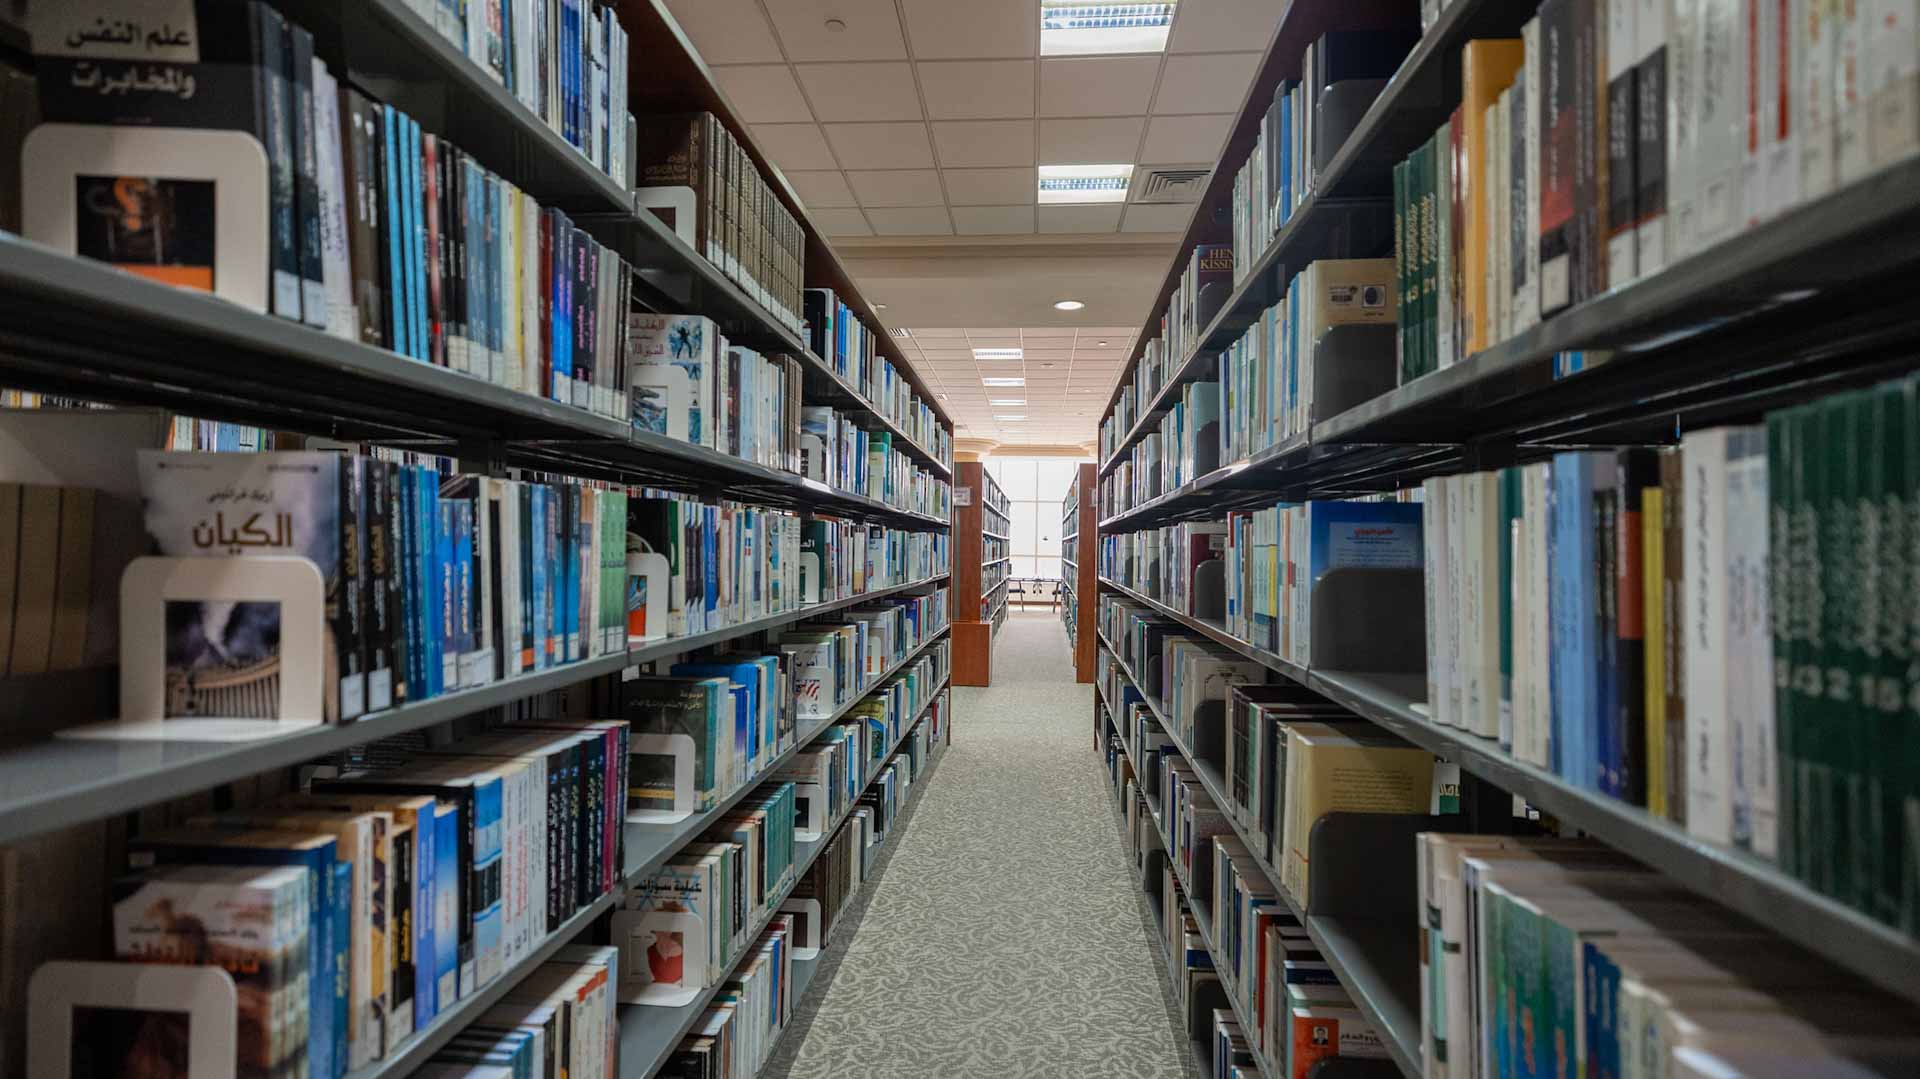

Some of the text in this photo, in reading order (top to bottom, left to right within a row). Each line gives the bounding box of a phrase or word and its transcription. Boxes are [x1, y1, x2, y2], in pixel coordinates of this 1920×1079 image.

[66, 19, 191, 52] علم النفس
[72, 62, 195, 99] والمخابرات
[193, 511, 292, 554] الكيان
